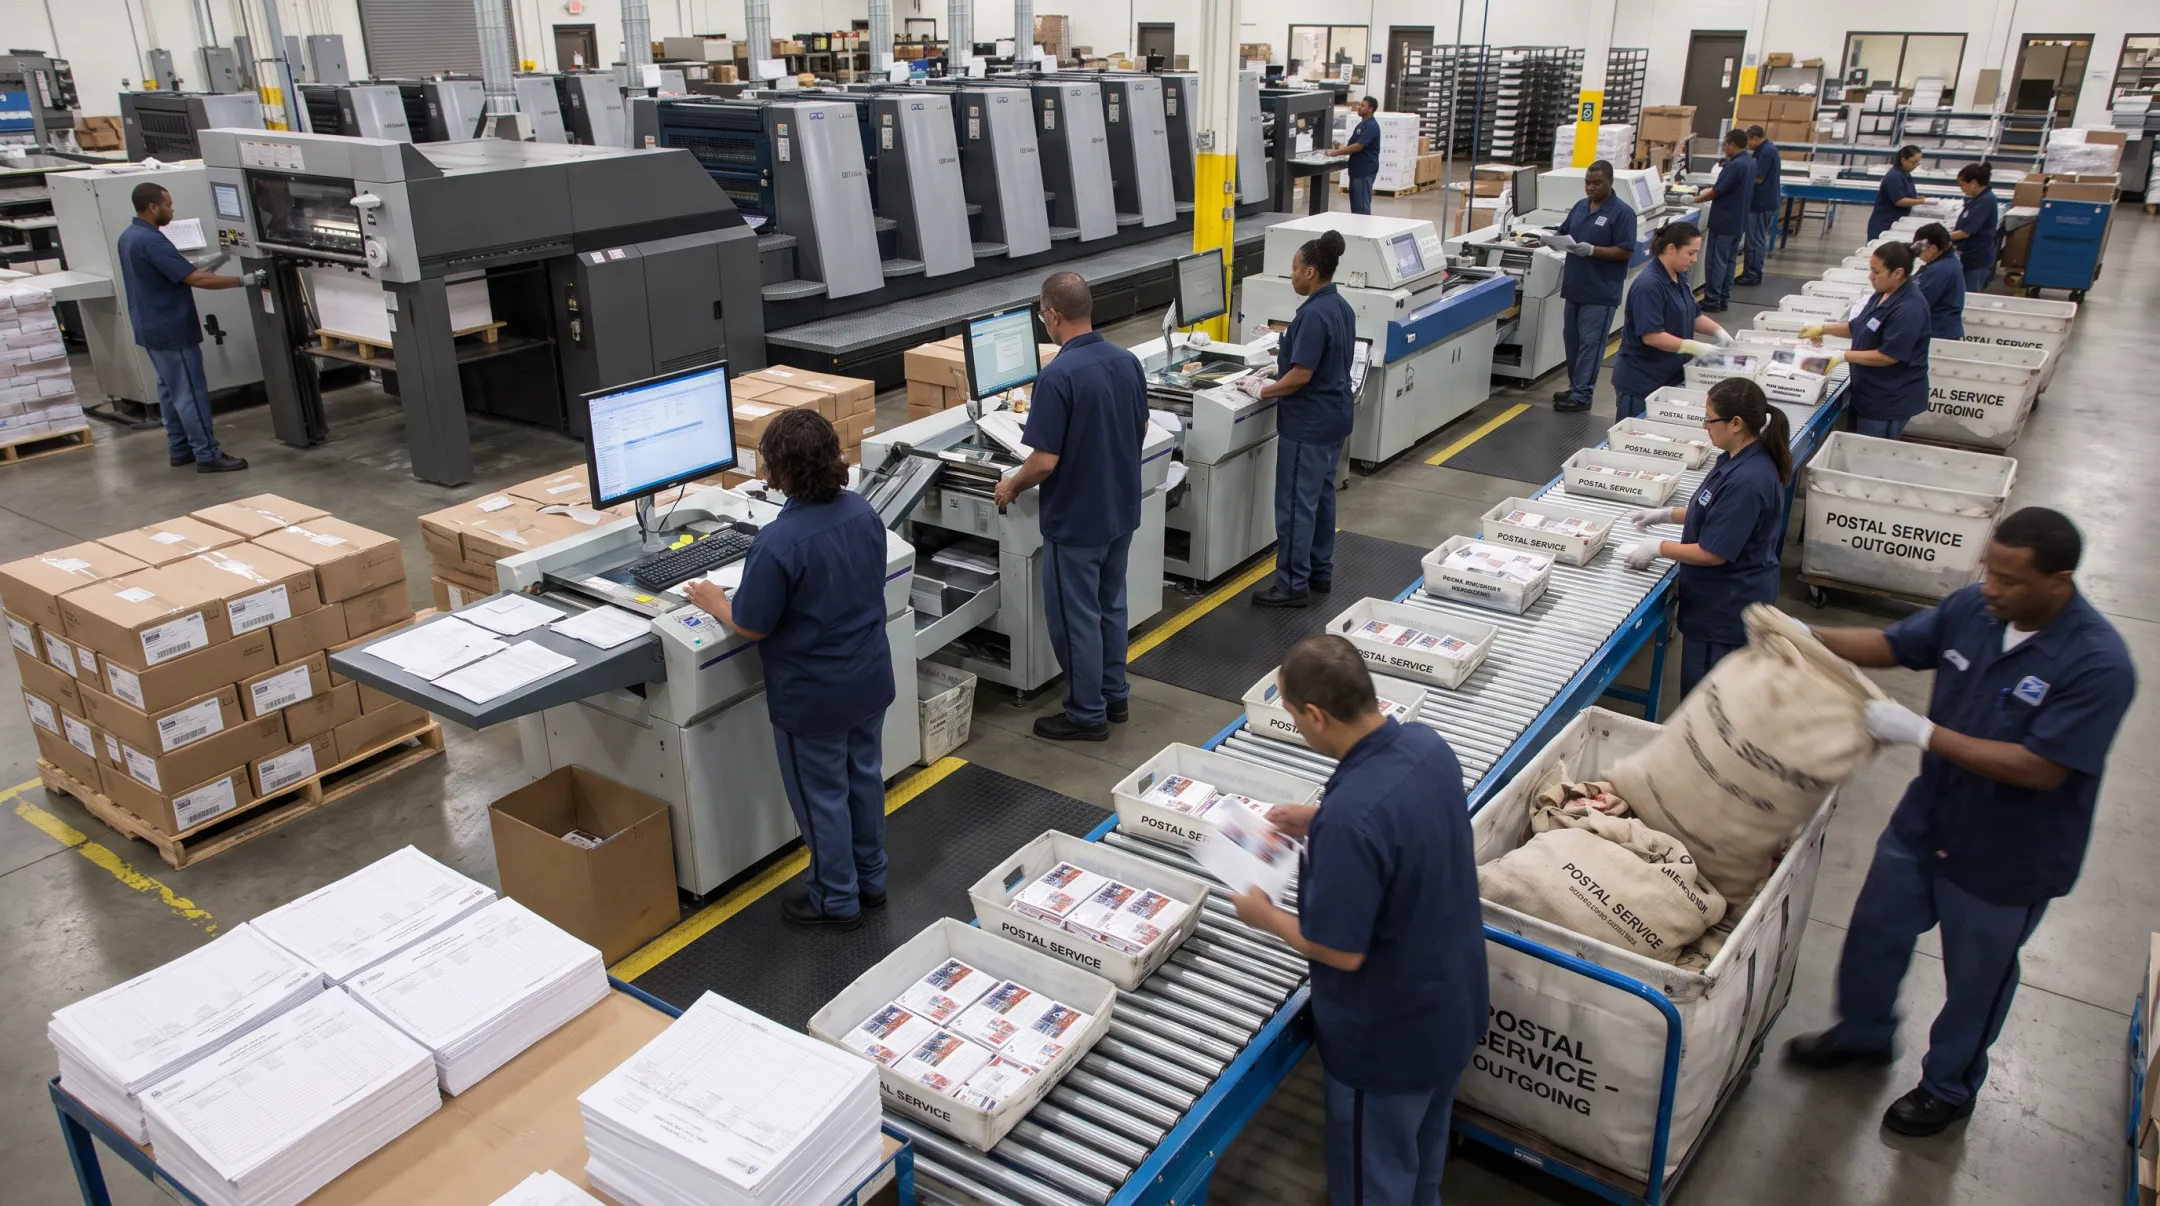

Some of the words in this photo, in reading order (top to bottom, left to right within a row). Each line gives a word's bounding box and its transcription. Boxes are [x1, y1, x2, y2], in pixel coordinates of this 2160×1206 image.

[1949, 389, 2005, 407] SERVICE
[1659, 410, 1685, 420] POSTAL
[1686, 414, 1707, 422] SERV
[1927, 401, 1985, 420] UTGOING
[1624, 444, 1651, 454] POSTAL
[1653, 449, 1684, 459] SERVICE
[1578, 478, 1607, 490] POSTAL
[1609, 484, 1643, 496] SERVICE
[1497, 532, 1528, 545] POSTAL
[1530, 539, 1566, 552] SERVICE
[1826, 512, 1887, 535] POSTAL
[1891, 524, 1963, 548] SERVICE
[1851, 535, 1936, 562] OUTGOING
[1357, 648, 1388, 663] OSTAL
[1390, 656, 1434, 674] SERVICE
[1270, 718, 1300, 734] POST
[1141, 815, 1185, 837] POSTAL
[1562, 862, 1613, 907] POSTAL
[1612, 903, 1664, 950] SERVICE
[1002, 922, 1048, 949] POSTAL
[1050, 941, 1102, 969] SERVICE
[1489, 1004, 1593, 1065] OSTAL
[1472, 1054, 1591, 1116] OUTGOING
[896, 1090, 951, 1123] SERVICE
